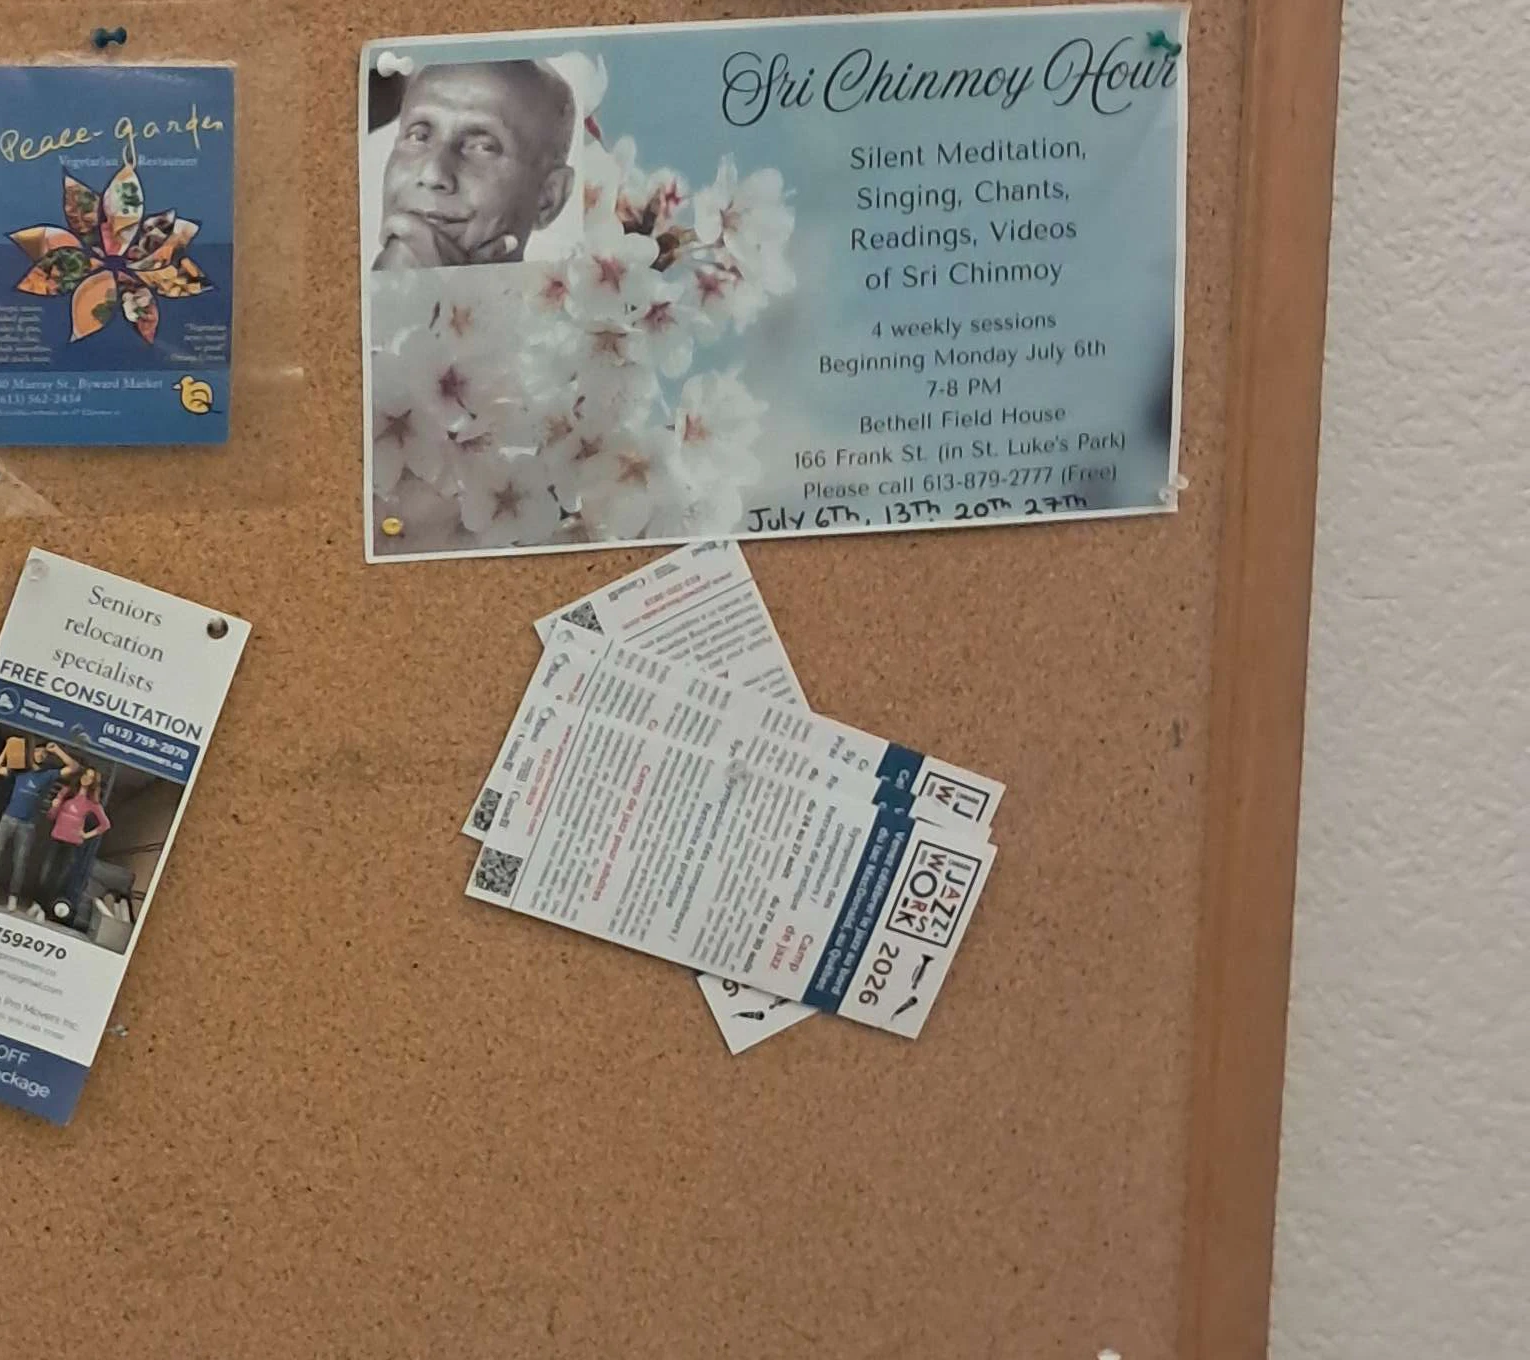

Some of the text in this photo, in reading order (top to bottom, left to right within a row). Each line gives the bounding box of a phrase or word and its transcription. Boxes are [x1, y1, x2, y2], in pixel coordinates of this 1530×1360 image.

[722, 36, 1177, 127] Sri Chinmoy Hour
[0, 125, 98, 163] Peace
[58, 154, 198, 169] Vegetarian Restaurant
[851, 139, 1087, 170] Silent Meditation,
[856, 179, 1070, 214] Singing, Chants,
[851, 219, 1077, 252] Readings, Videos
[865, 261, 1063, 290] of Sri Chinmoy
[872, 313, 1056, 338] 4 weekly sessions
[820, 340, 1107, 376] Beginning Monday July 6th
[13, 378, 53, 392] Murray
[78, 377, 120, 392] Byward
[123, 377, 163, 390] Market
[927, 378, 1002, 398] 7-8 PM
[860, 406, 1066, 434] Bethell Field House
[795, 431, 1127, 470] 166 Frank St. (in St. Luke's Park)
[804, 464, 1118, 500] Please call 613-879-2777 (Free)
[747, 506, 805, 534] July
[88, 585, 163, 627] Seniors
[64, 616, 164, 663] relocation
[53, 647, 155, 693] specialists
[0, 659, 48, 688] FREE
[51, 676, 203, 741] CONSULTATION
[630, 763, 652, 797] Camp
[625, 796, 638, 812] de
[614, 811, 631, 834] jazz
[874, 825, 889, 843] du
[830, 829, 904, 996] Venez célébrer le jazz au bord
[766, 923, 796, 971] de jazz
[787, 932, 814, 974] Camp
[857, 940, 900, 1009] 2026
